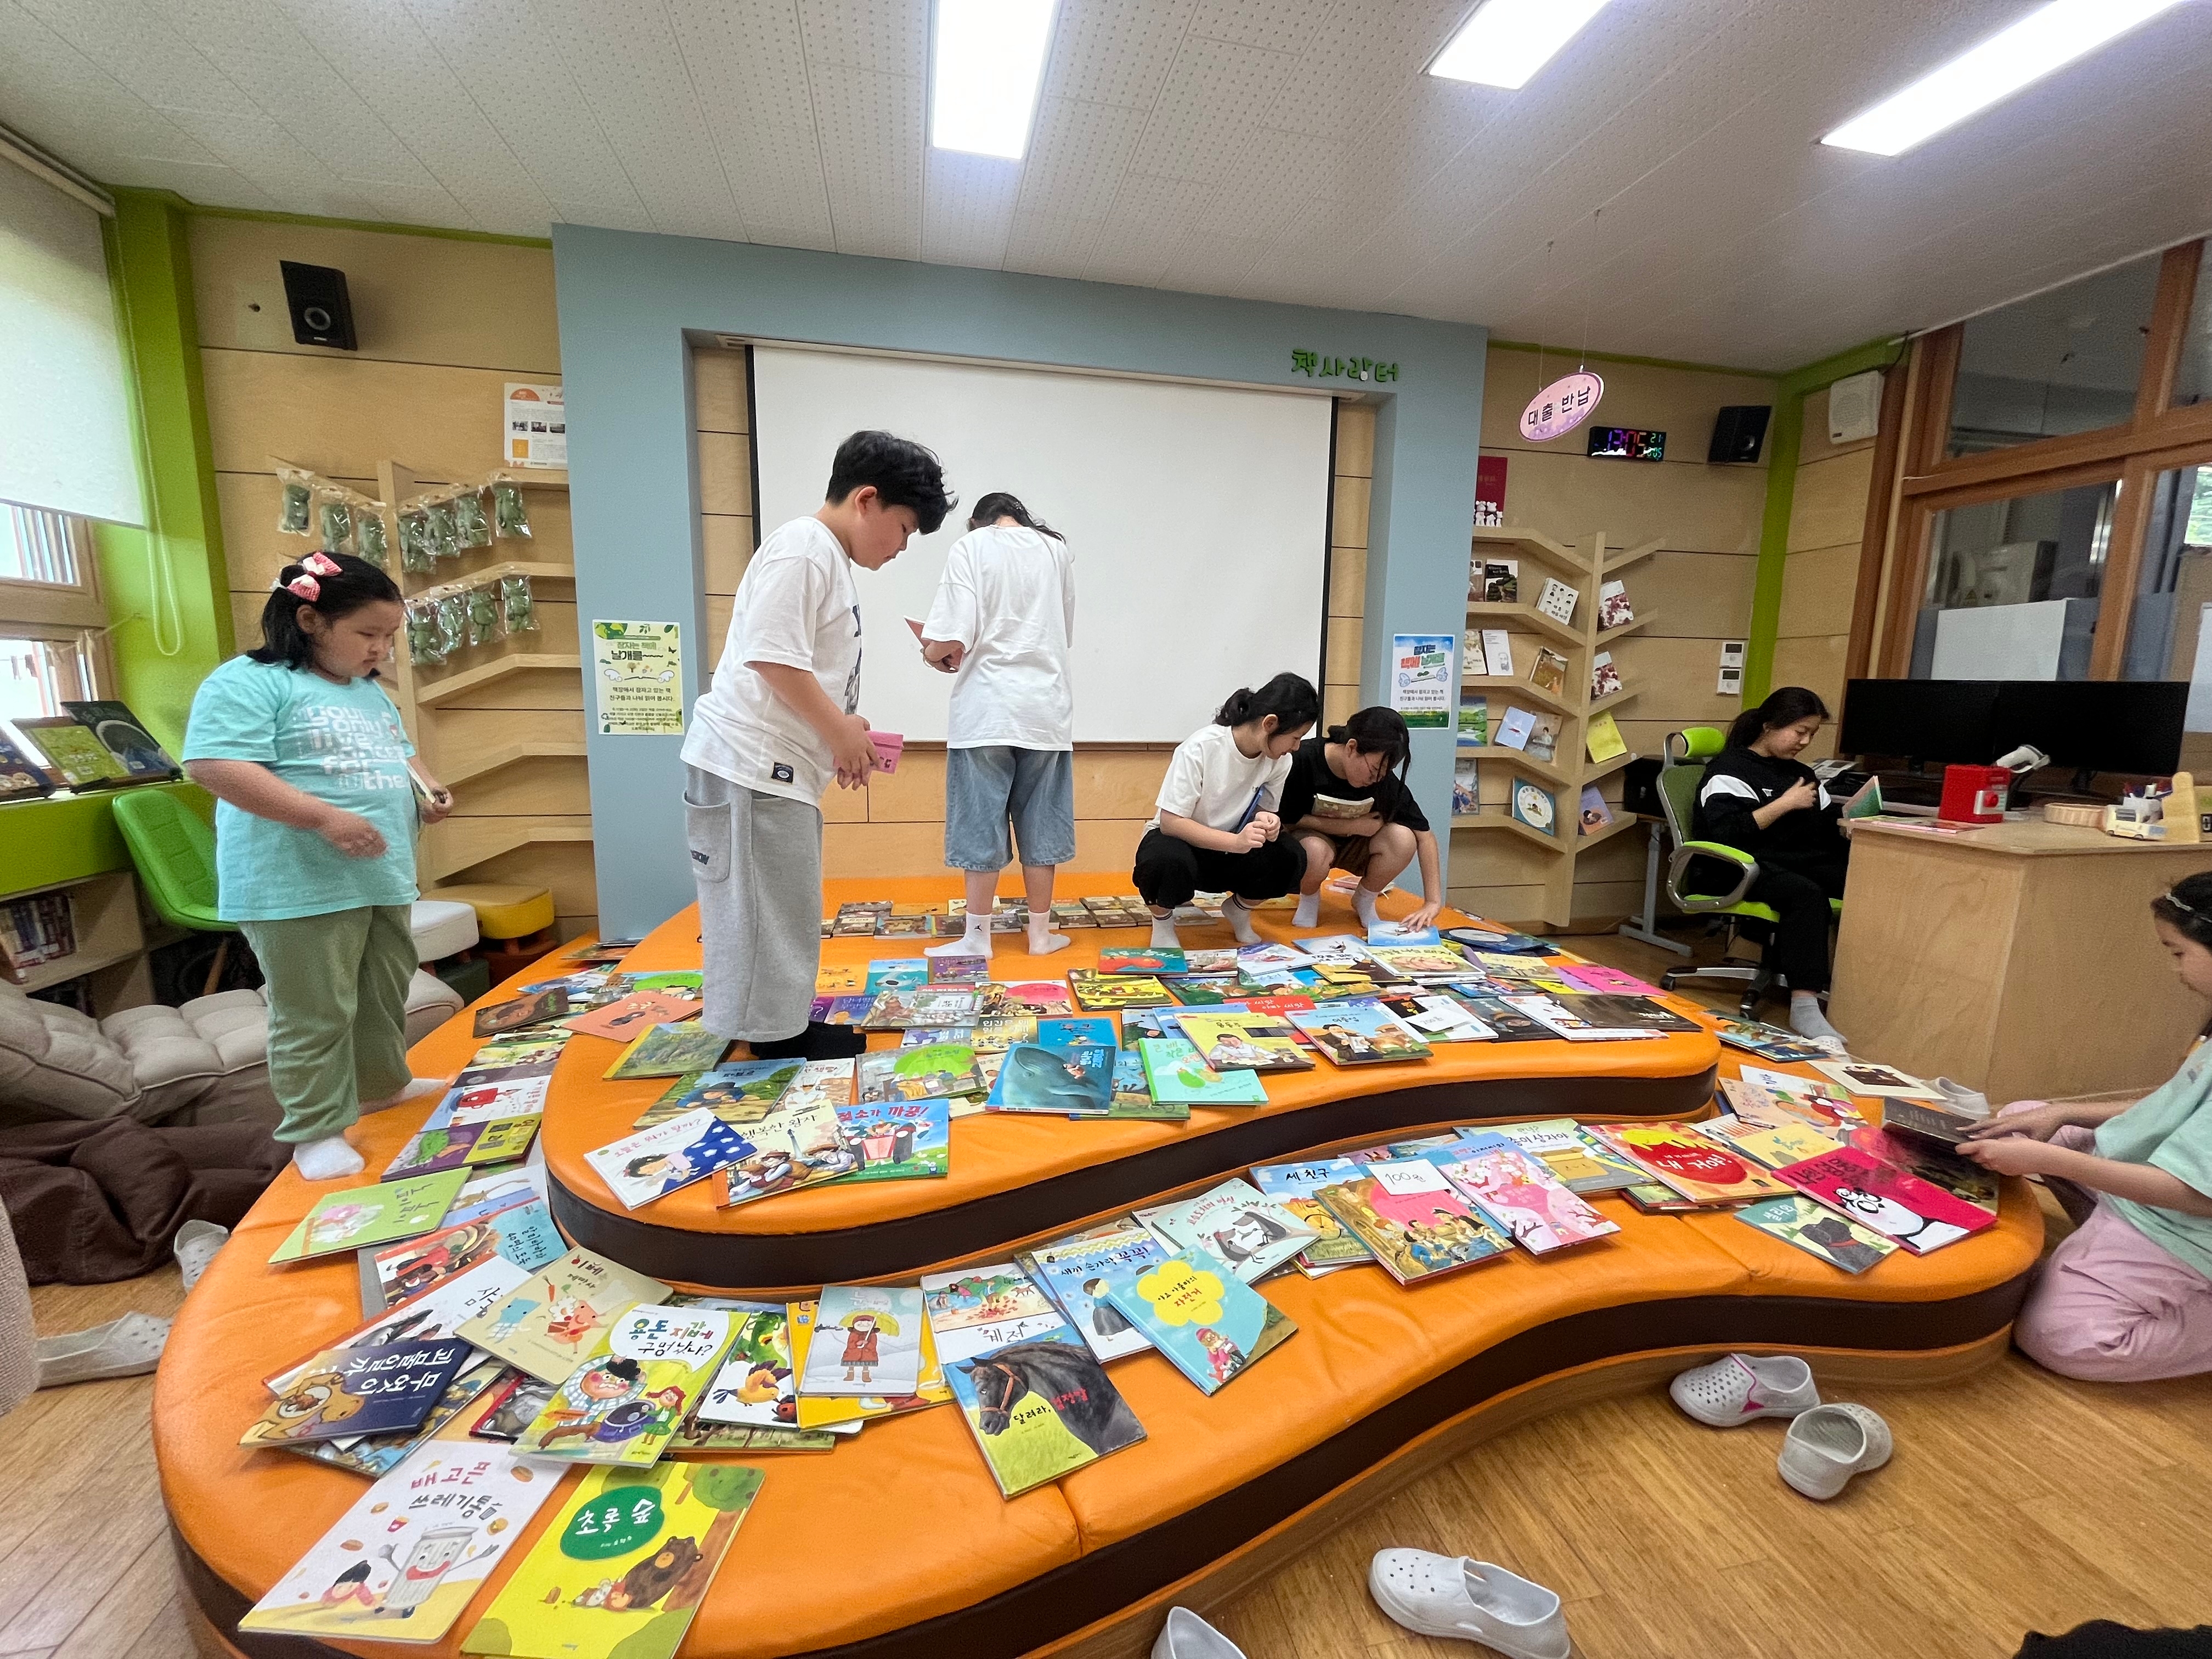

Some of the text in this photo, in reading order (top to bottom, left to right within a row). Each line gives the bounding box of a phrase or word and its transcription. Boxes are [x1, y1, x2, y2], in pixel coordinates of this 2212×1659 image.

[363, 770, 405, 790] the
[888, 1105, 929, 1119] 까꿍!
[741, 1114, 817, 1141] 행복한 왕자
[1532, 1132, 1570, 1143] 상자야
[1655, 1160, 1685, 1170] 내
[1686, 1153, 1733, 1170] 거야!
[1285, 1168, 1330, 1182] 세 친구
[1060, 1248, 1149, 1278] 새끼 손가락 꼭꼭!
[1173, 1287, 1203, 1307] 자전거
[629, 1318, 714, 1341] 용돈 지갑에
[360, 1371, 443, 1396] 무엇이
[575, 1498, 656, 1536] 초록 숲
